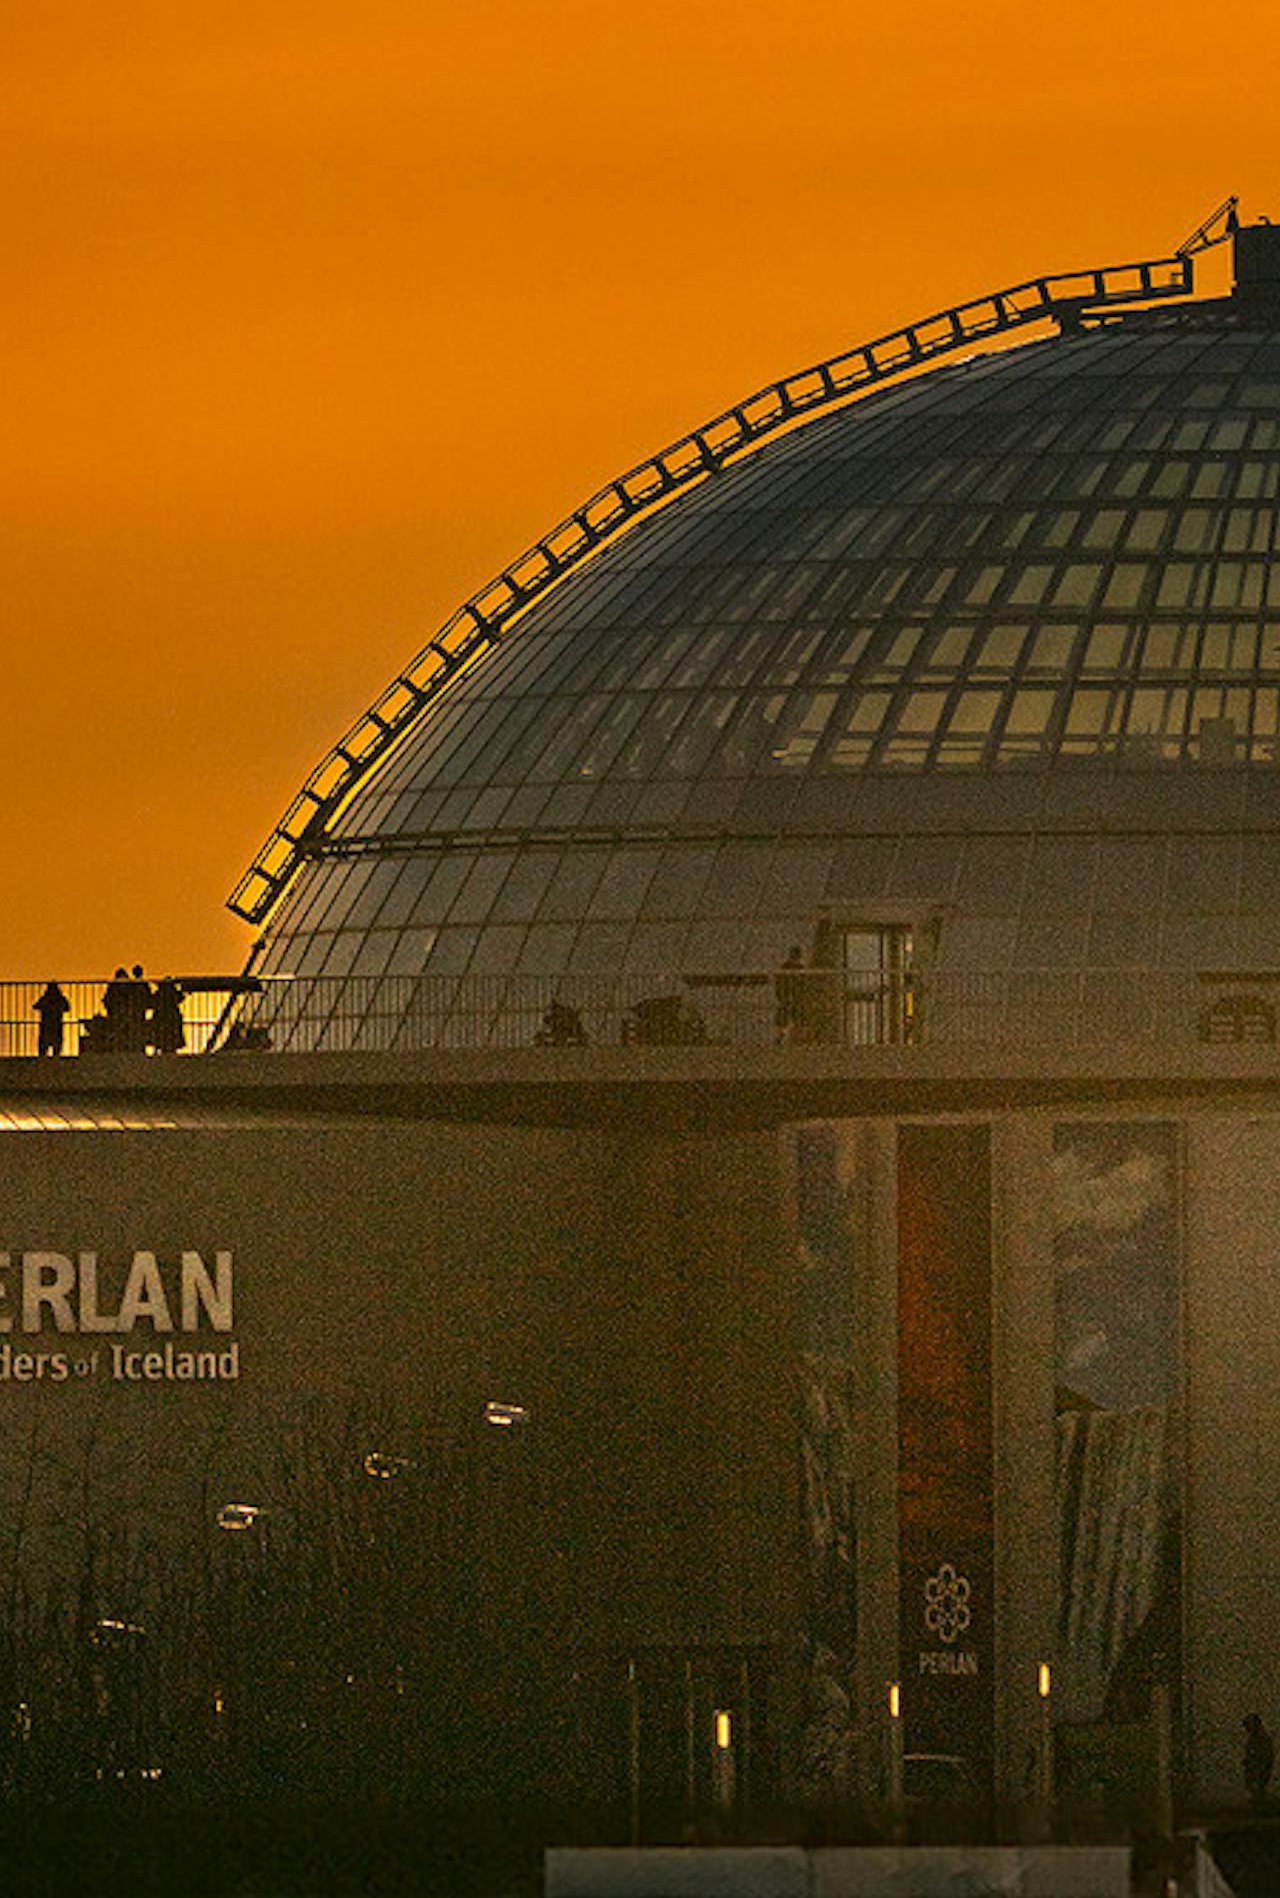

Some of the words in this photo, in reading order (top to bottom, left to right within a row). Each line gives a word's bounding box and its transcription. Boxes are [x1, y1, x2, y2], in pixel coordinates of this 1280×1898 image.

[76, 1352, 98, 1376] of
[112, 1344, 240, 1380] Iceland
[919, 1651, 979, 1675] PERLAN
